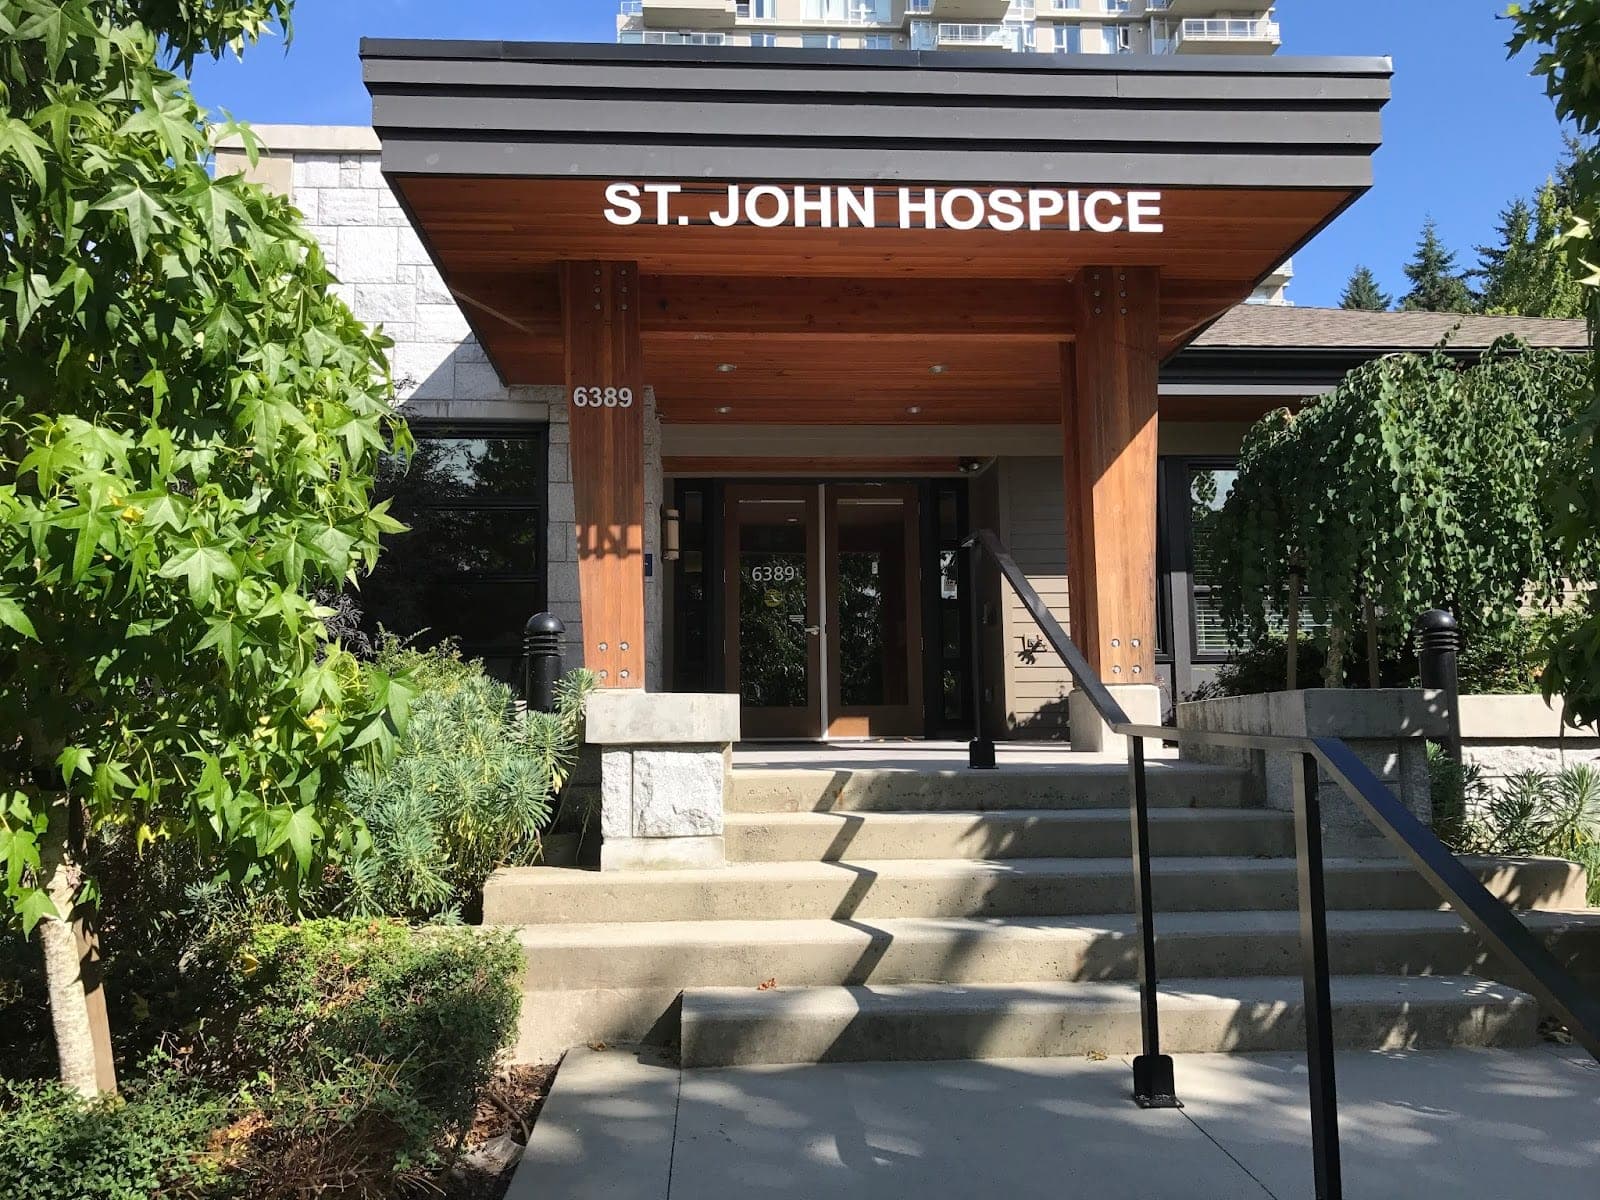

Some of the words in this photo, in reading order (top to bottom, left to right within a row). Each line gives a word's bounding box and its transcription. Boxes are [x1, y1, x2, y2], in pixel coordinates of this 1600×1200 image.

[603, 183, 690, 227] ST.
[709, 185, 876, 229] JOHN
[897, 187, 1165, 233] HOSPICE
[573, 386, 633, 408] 6389
[751, 566, 795, 582] 6389
